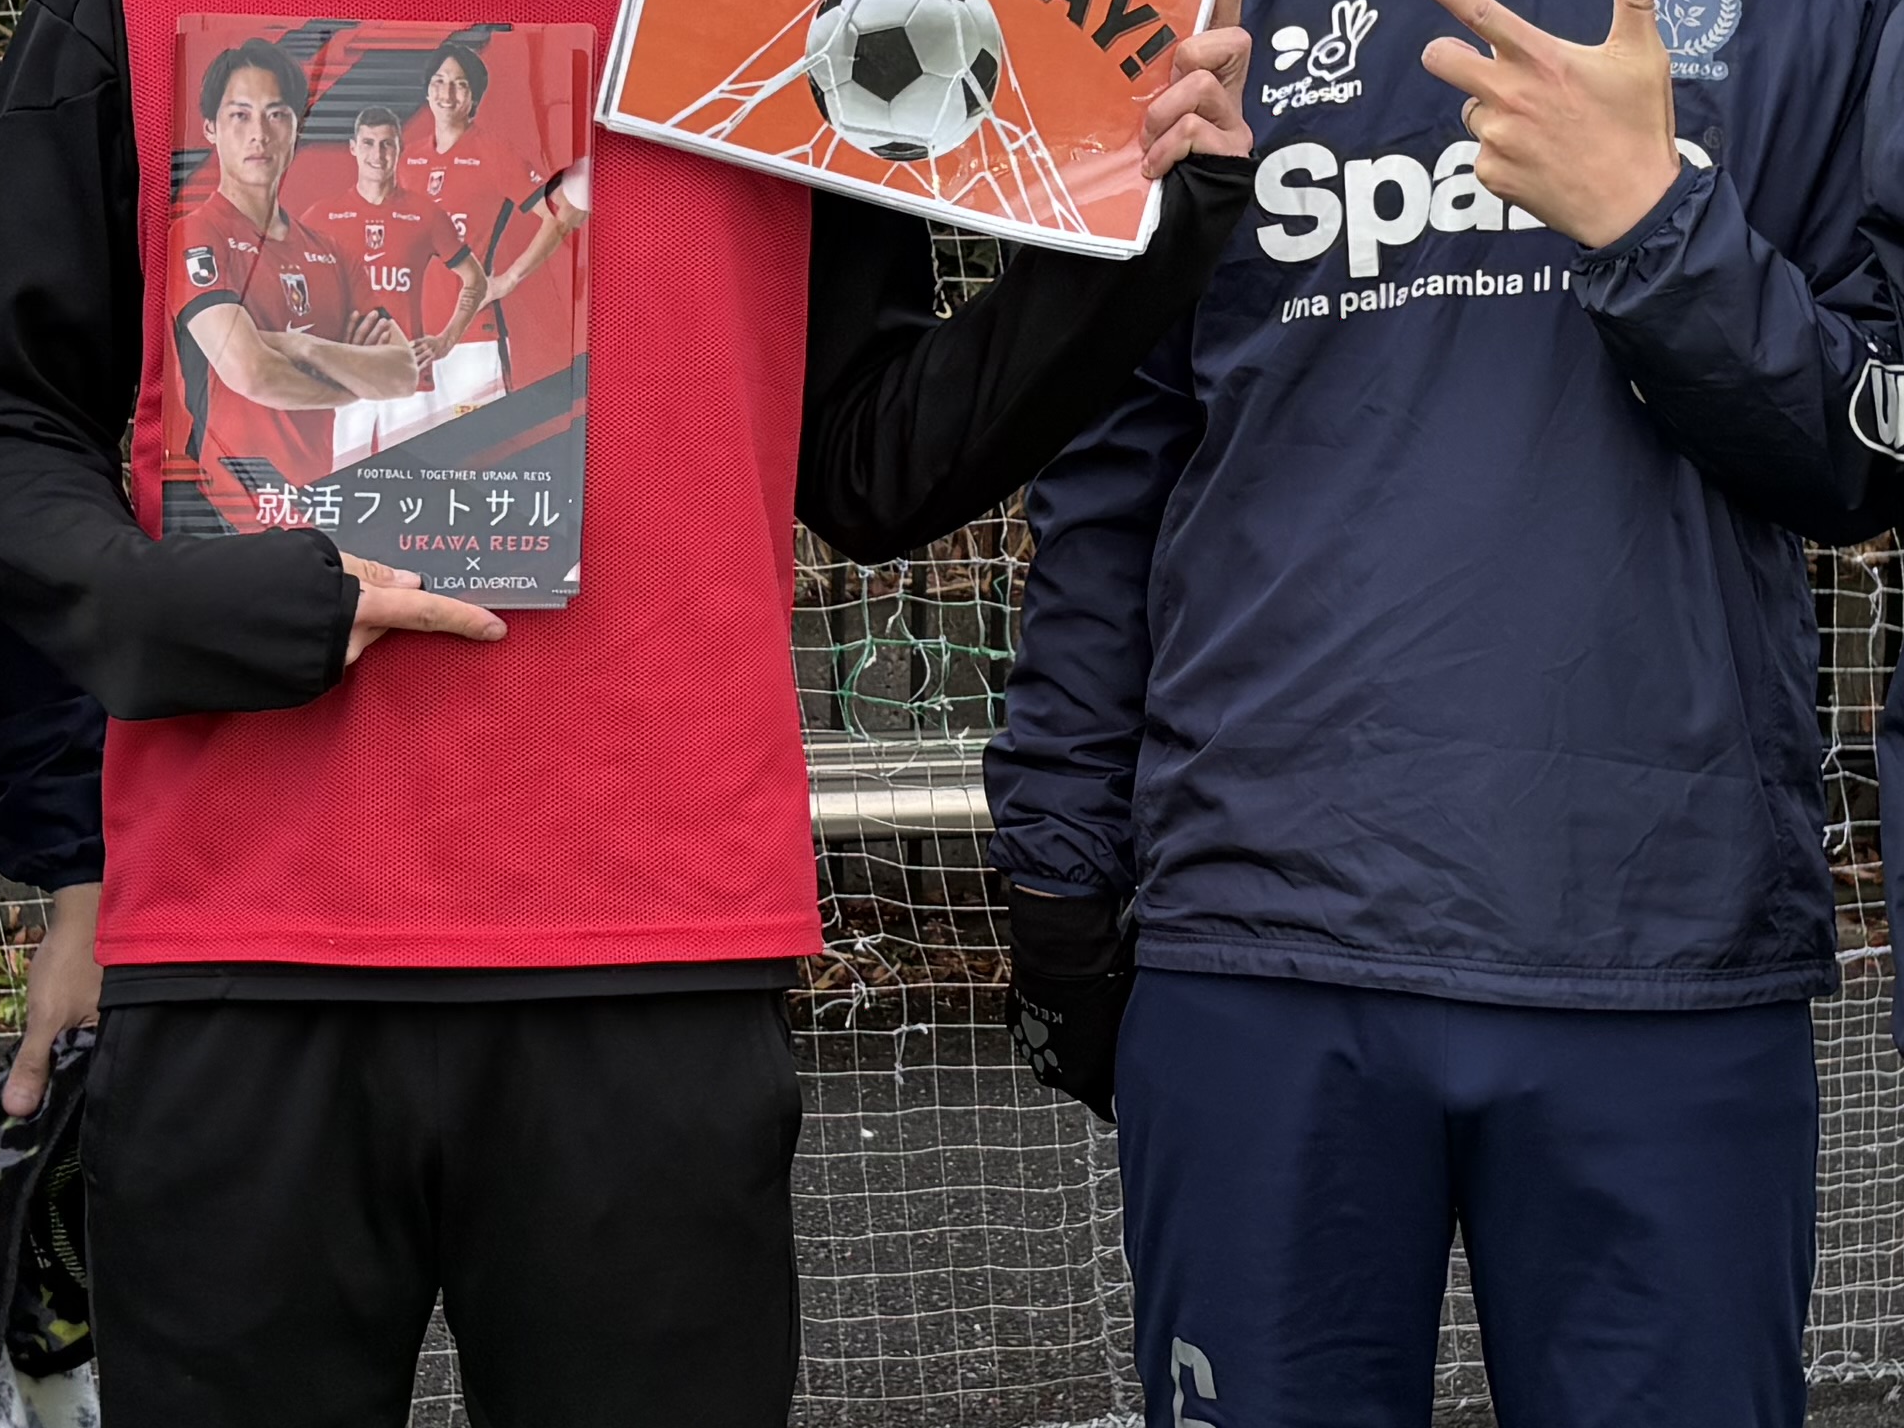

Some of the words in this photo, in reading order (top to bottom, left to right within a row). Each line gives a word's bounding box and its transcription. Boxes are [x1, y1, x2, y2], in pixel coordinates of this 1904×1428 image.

[1290, 78, 1362, 108] design
[364, 264, 412, 292] LUS
[1281, 291, 1329, 323] Una
[1339, 285, 1408, 320] palla
[1411, 268, 1524, 300] cambia
[1533, 266, 1551, 292] il
[357, 468, 413, 480] FOOTBALL
[420, 469, 476, 481] TOGETHER
[523, 471, 552, 482] REDS
[255, 482, 560, 527] 就活フットサル
[399, 534, 480, 551] URAWA
[490, 534, 550, 552] REDS
